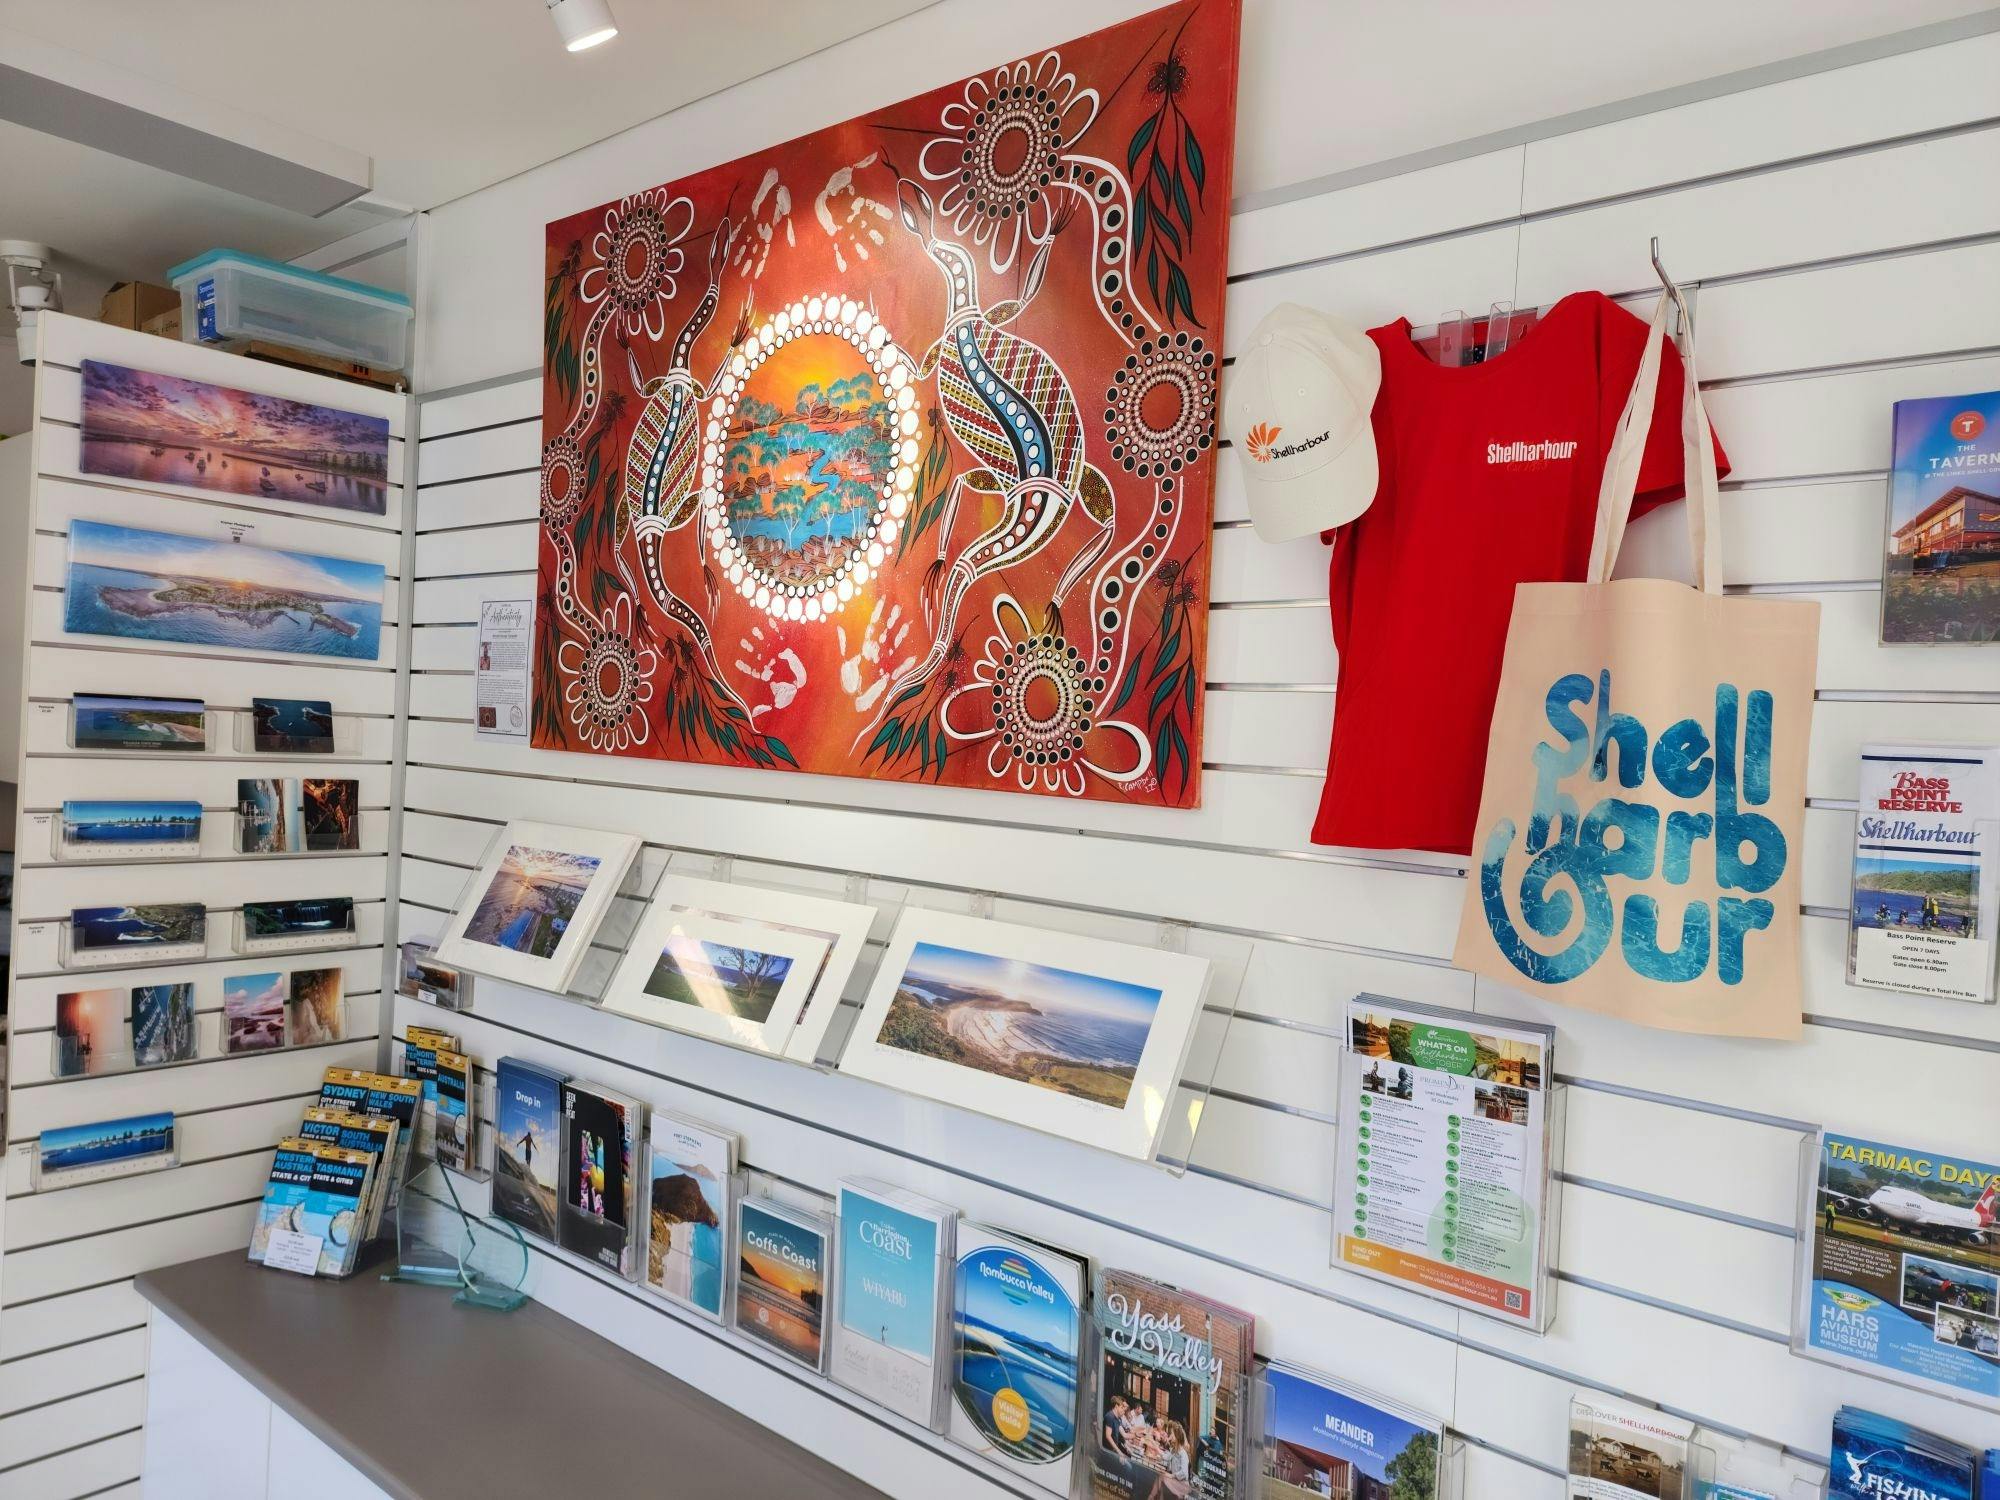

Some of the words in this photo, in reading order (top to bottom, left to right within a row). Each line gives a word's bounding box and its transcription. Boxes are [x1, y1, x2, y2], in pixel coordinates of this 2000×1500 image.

[1962, 420, 1975, 433] T
[1271, 430, 1330, 459] Shellharbour
[1487, 439, 1578, 464] Shellharbour
[1957, 444, 1976, 452] THE
[1929, 451, 2000, 469] TAVERN
[1890, 788, 1950, 801] POINT
[1878, 799, 1963, 814] RESERVE
[1858, 817, 1980, 845] Shellharbour
[1887, 931, 1904, 940] Bass
[1905, 934, 1925, 942] Point
[1926, 936, 1957, 946] Reserve
[1862, 977, 1885, 986] Reserve
[1891, 981, 1911, 989] closed
[1911, 984, 1931, 993] during
[1936, 986, 1951, 994] Total
[1417, 1038, 1452, 1052] WHAT'S
[1453, 1045, 1468, 1054] ON
[1422, 1056, 1463, 1069] OCTOBER
[323, 1085, 367, 1100] SYDNEY
[370, 1091, 387, 1100] NEW
[388, 1093, 415, 1103] SOUTH
[516, 1090, 533, 1106] Drop
[533, 1098, 541, 1110] in
[369, 1099, 393, 1109] WALES
[304, 1122, 340, 1136] VICTOR
[341, 1130, 370, 1141] SOUTH
[340, 1139, 383, 1153] AUSTRALIA
[274, 1161, 313, 1172] AUSTRAL
[1828, 1141, 1932, 1178] TARMAC
[272, 1171, 292, 1181] STATE
[316, 1162, 363, 1178] TASMANIA
[313, 1173, 330, 1182] STATE
[336, 1177, 354, 1186] CITIES
[860, 1220, 912, 1260] Coast
[747, 1230, 778, 1255] Coffs
[782, 1245, 817, 1272] Coast
[1400, 1259, 1418, 1270] Phone:
[980, 1261, 1026, 1290] Nambucca
[1026, 1280, 1055, 1304] Valley
[863, 1277, 907, 1309] WIYABU
[1107, 1294, 1185, 1351] Yass
[1821, 1304, 1880, 1332] HARS
[1820, 1319, 1879, 1343] AVIATION
[1820, 1328, 1878, 1353] MUSEUM
[1140, 1330, 1223, 1395] Valley
[1576, 1408, 1618, 1423] DISCOVER
[1325, 1414, 1374, 1448] MEANDER
[1867, 1472, 1950, 1500] FISHIN
